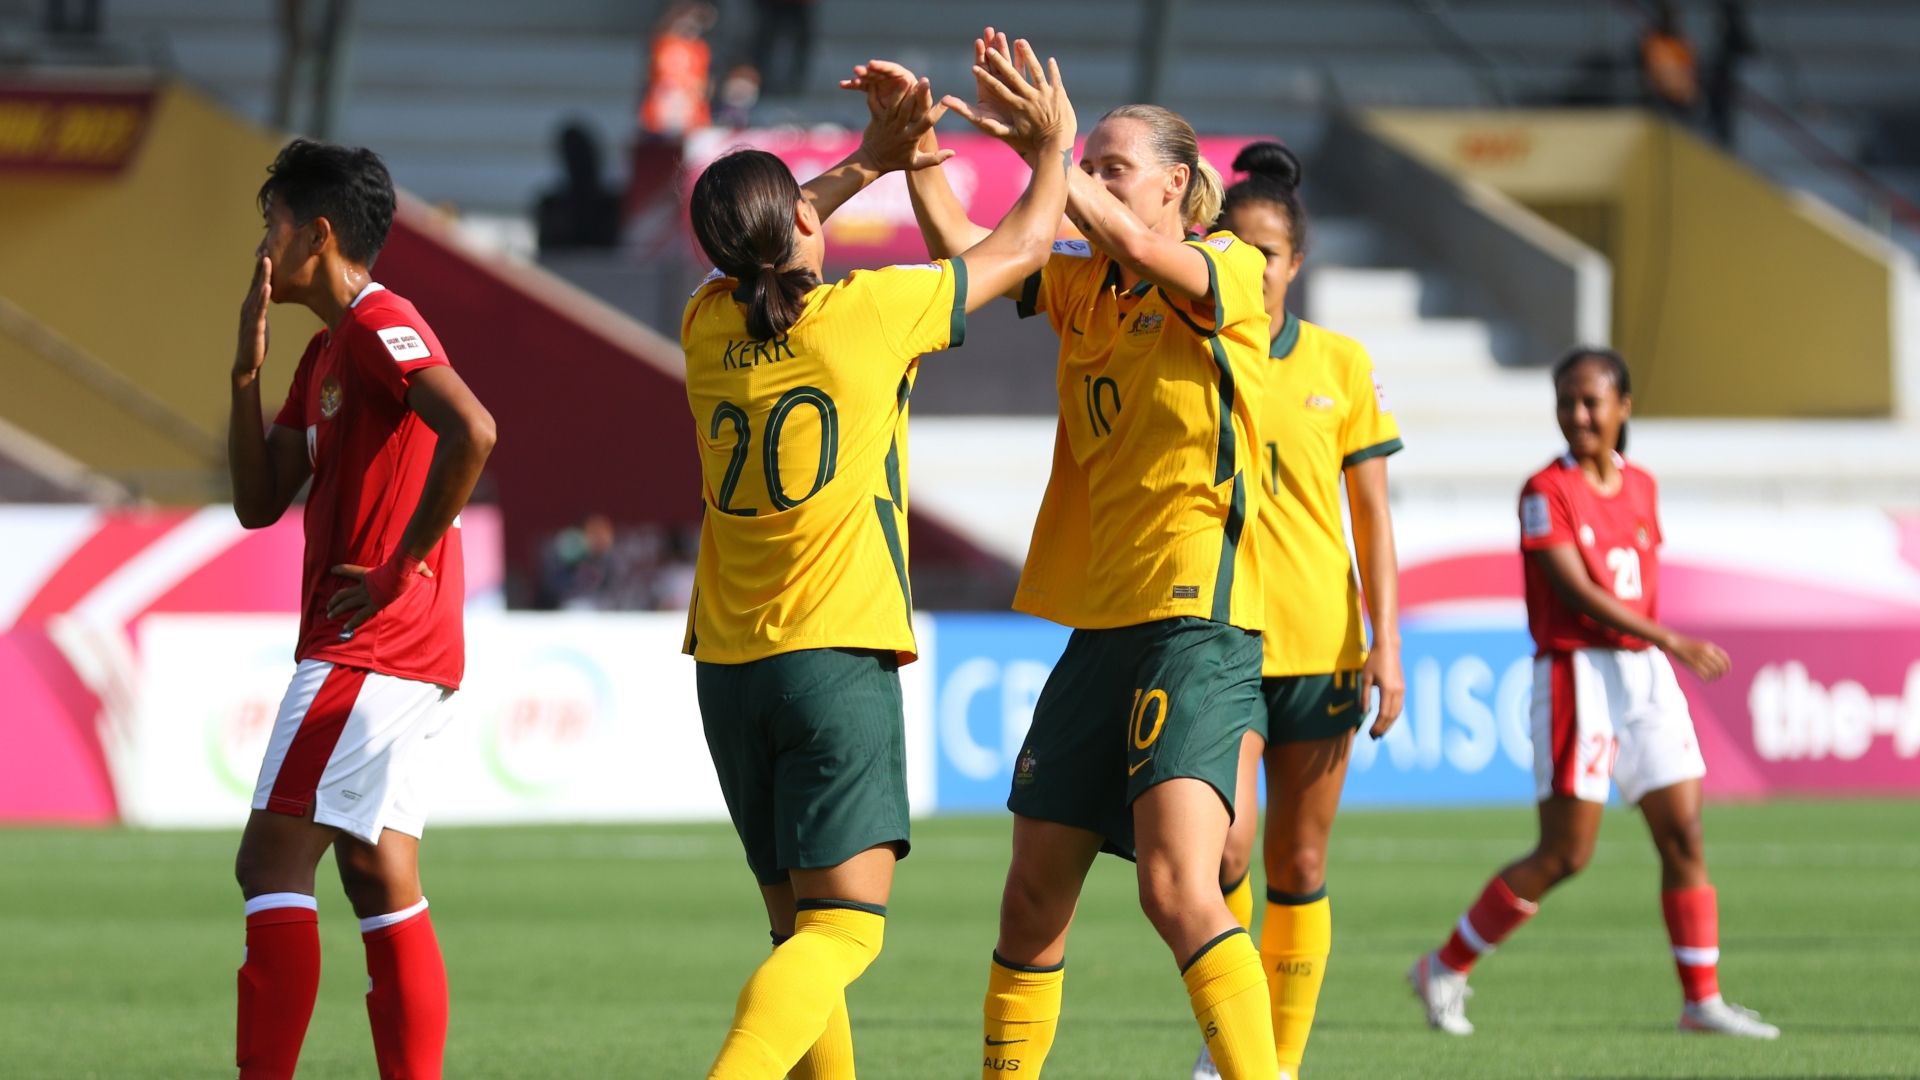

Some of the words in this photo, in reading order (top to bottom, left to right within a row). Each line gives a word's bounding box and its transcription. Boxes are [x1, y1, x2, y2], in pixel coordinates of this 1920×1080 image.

[723, 333, 795, 371] KERR
[1084, 374, 1121, 438] 10
[711, 385, 838, 517] 20
[1606, 547, 1643, 600] 21
[1128, 688, 1168, 751] 10
[1275, 960, 1313, 977] AUS
[983, 1056, 1021, 1071] AUS
